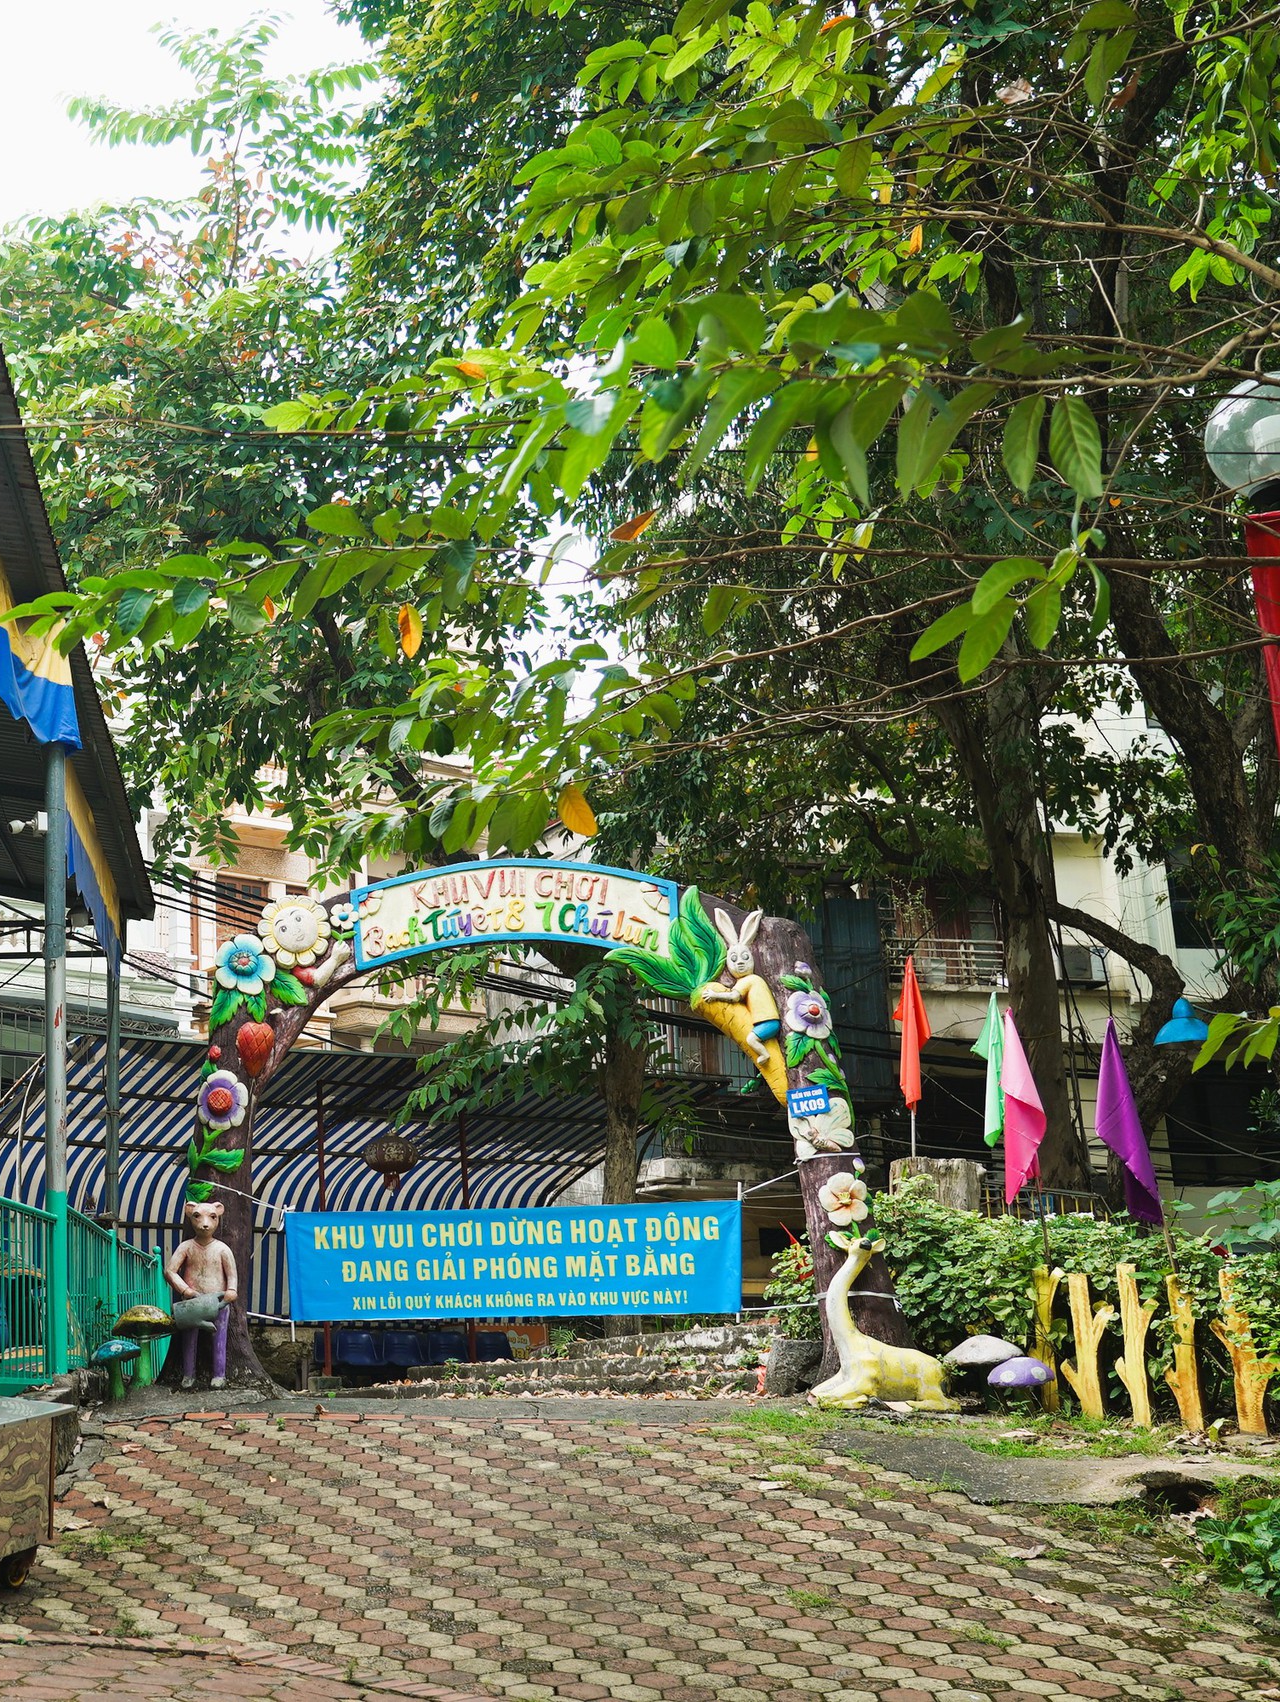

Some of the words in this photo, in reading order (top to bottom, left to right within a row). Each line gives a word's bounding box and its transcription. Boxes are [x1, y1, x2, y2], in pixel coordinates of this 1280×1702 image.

[410, 875, 469, 912] KHU
[470, 869, 526, 899] VUI
[535, 870, 609, 906] CHƠI
[534, 901, 555, 932] 7
[792, 1098, 825, 1113] LK09
[314, 1225, 366, 1250] KHU
[372, 1223, 414, 1248] VUI
[422, 1220, 483, 1247] CHƠI
[491, 1216, 563, 1245] DỪNG
[570, 1218, 638, 1248] HOẠT
[645, 1212, 719, 1246] ĐỘNG
[342, 1259, 409, 1282] ĐANG
[415, 1251, 466, 1281] GIẢI
[473, 1252, 558, 1280] PHÓNG
[565, 1250, 619, 1282] MẶT
[625, 1245, 696, 1276] BẰNG
[352, 1296, 376, 1310] XIN
[380, 1291, 402, 1309] LỖI
[404, 1292, 431, 1310] QUÝ
[435, 1291, 482, 1309] KHÁCH
[485, 1290, 534, 1308] KHÔNG
[537, 1292, 556, 1306] RA
[558, 1289, 586, 1306] VÀO
[589, 1291, 618, 1306] KHU
[622, 1289, 650, 1308] VỰC
[653, 1287, 689, 1305] NÀY!
